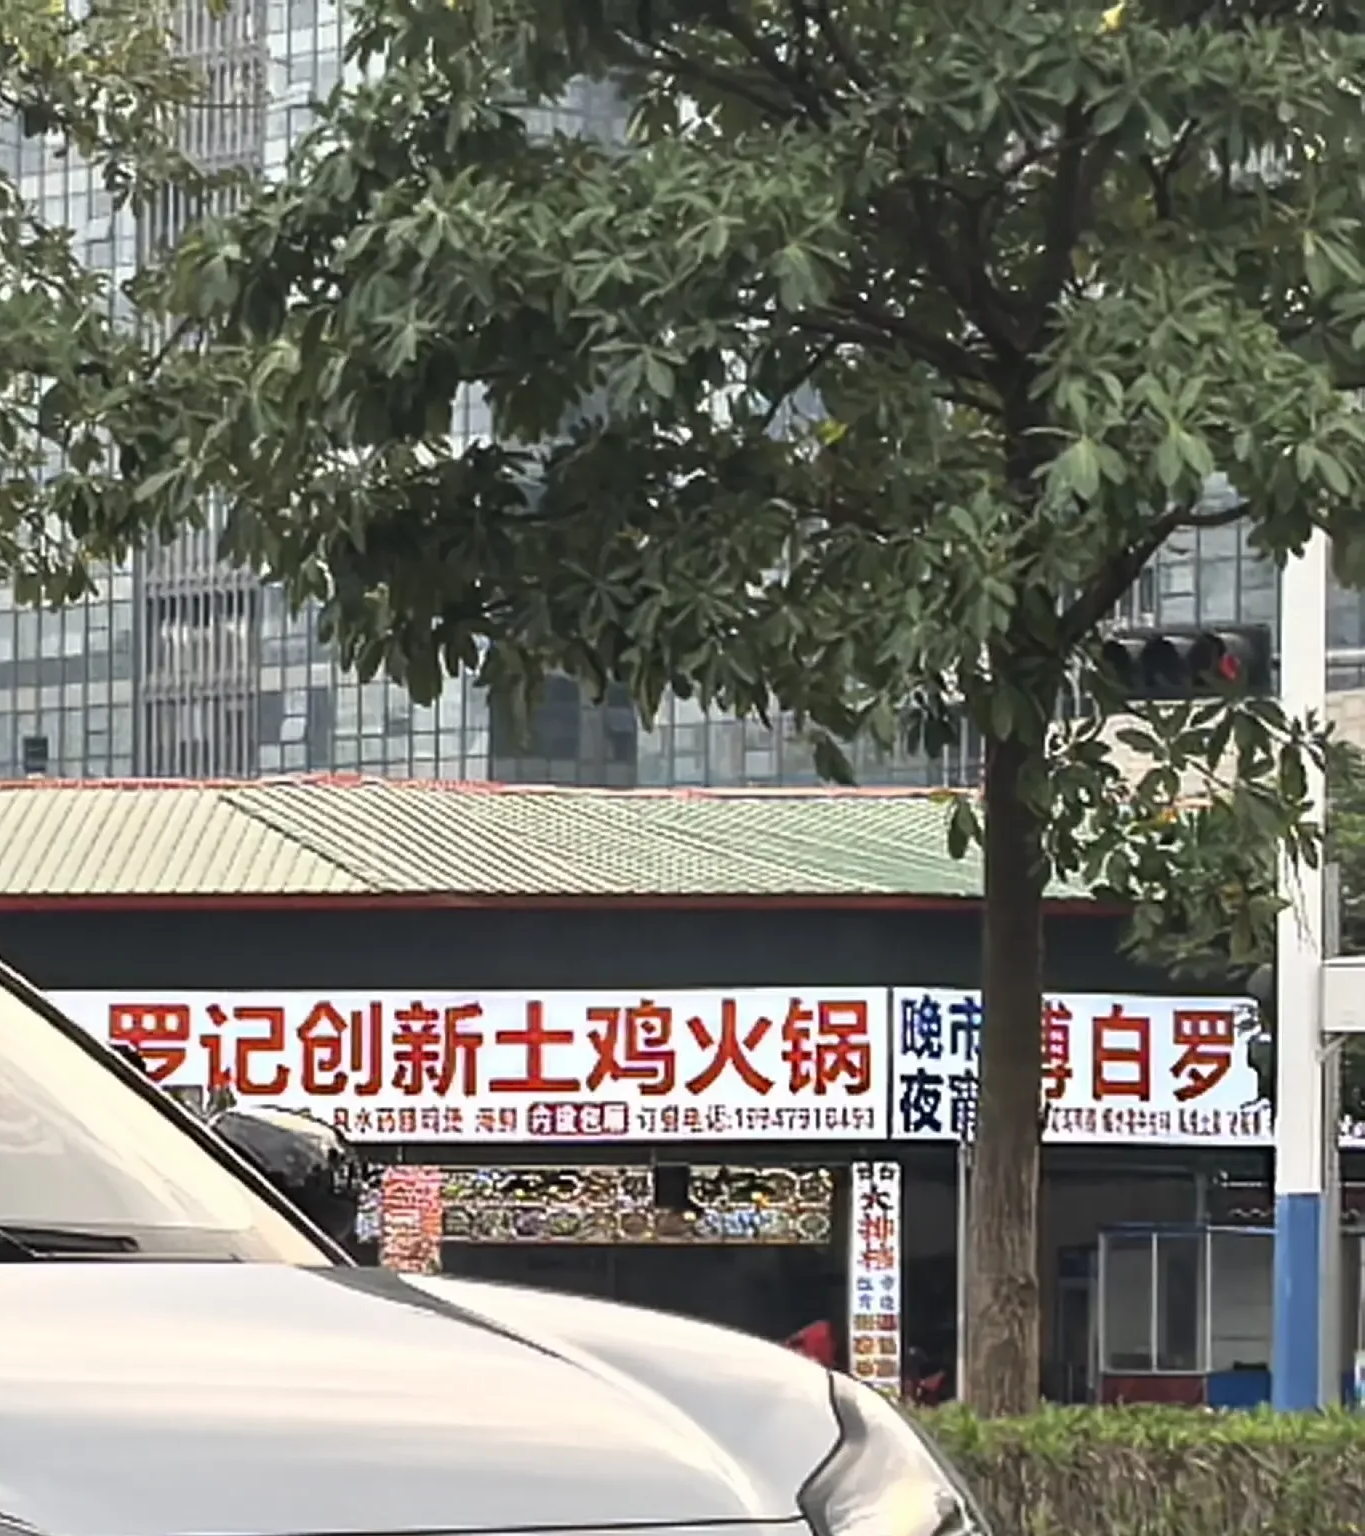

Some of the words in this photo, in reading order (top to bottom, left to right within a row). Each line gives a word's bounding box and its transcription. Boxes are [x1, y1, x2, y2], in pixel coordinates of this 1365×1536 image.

[108, 998, 869, 1097] 罗记创新土鸡火锅
